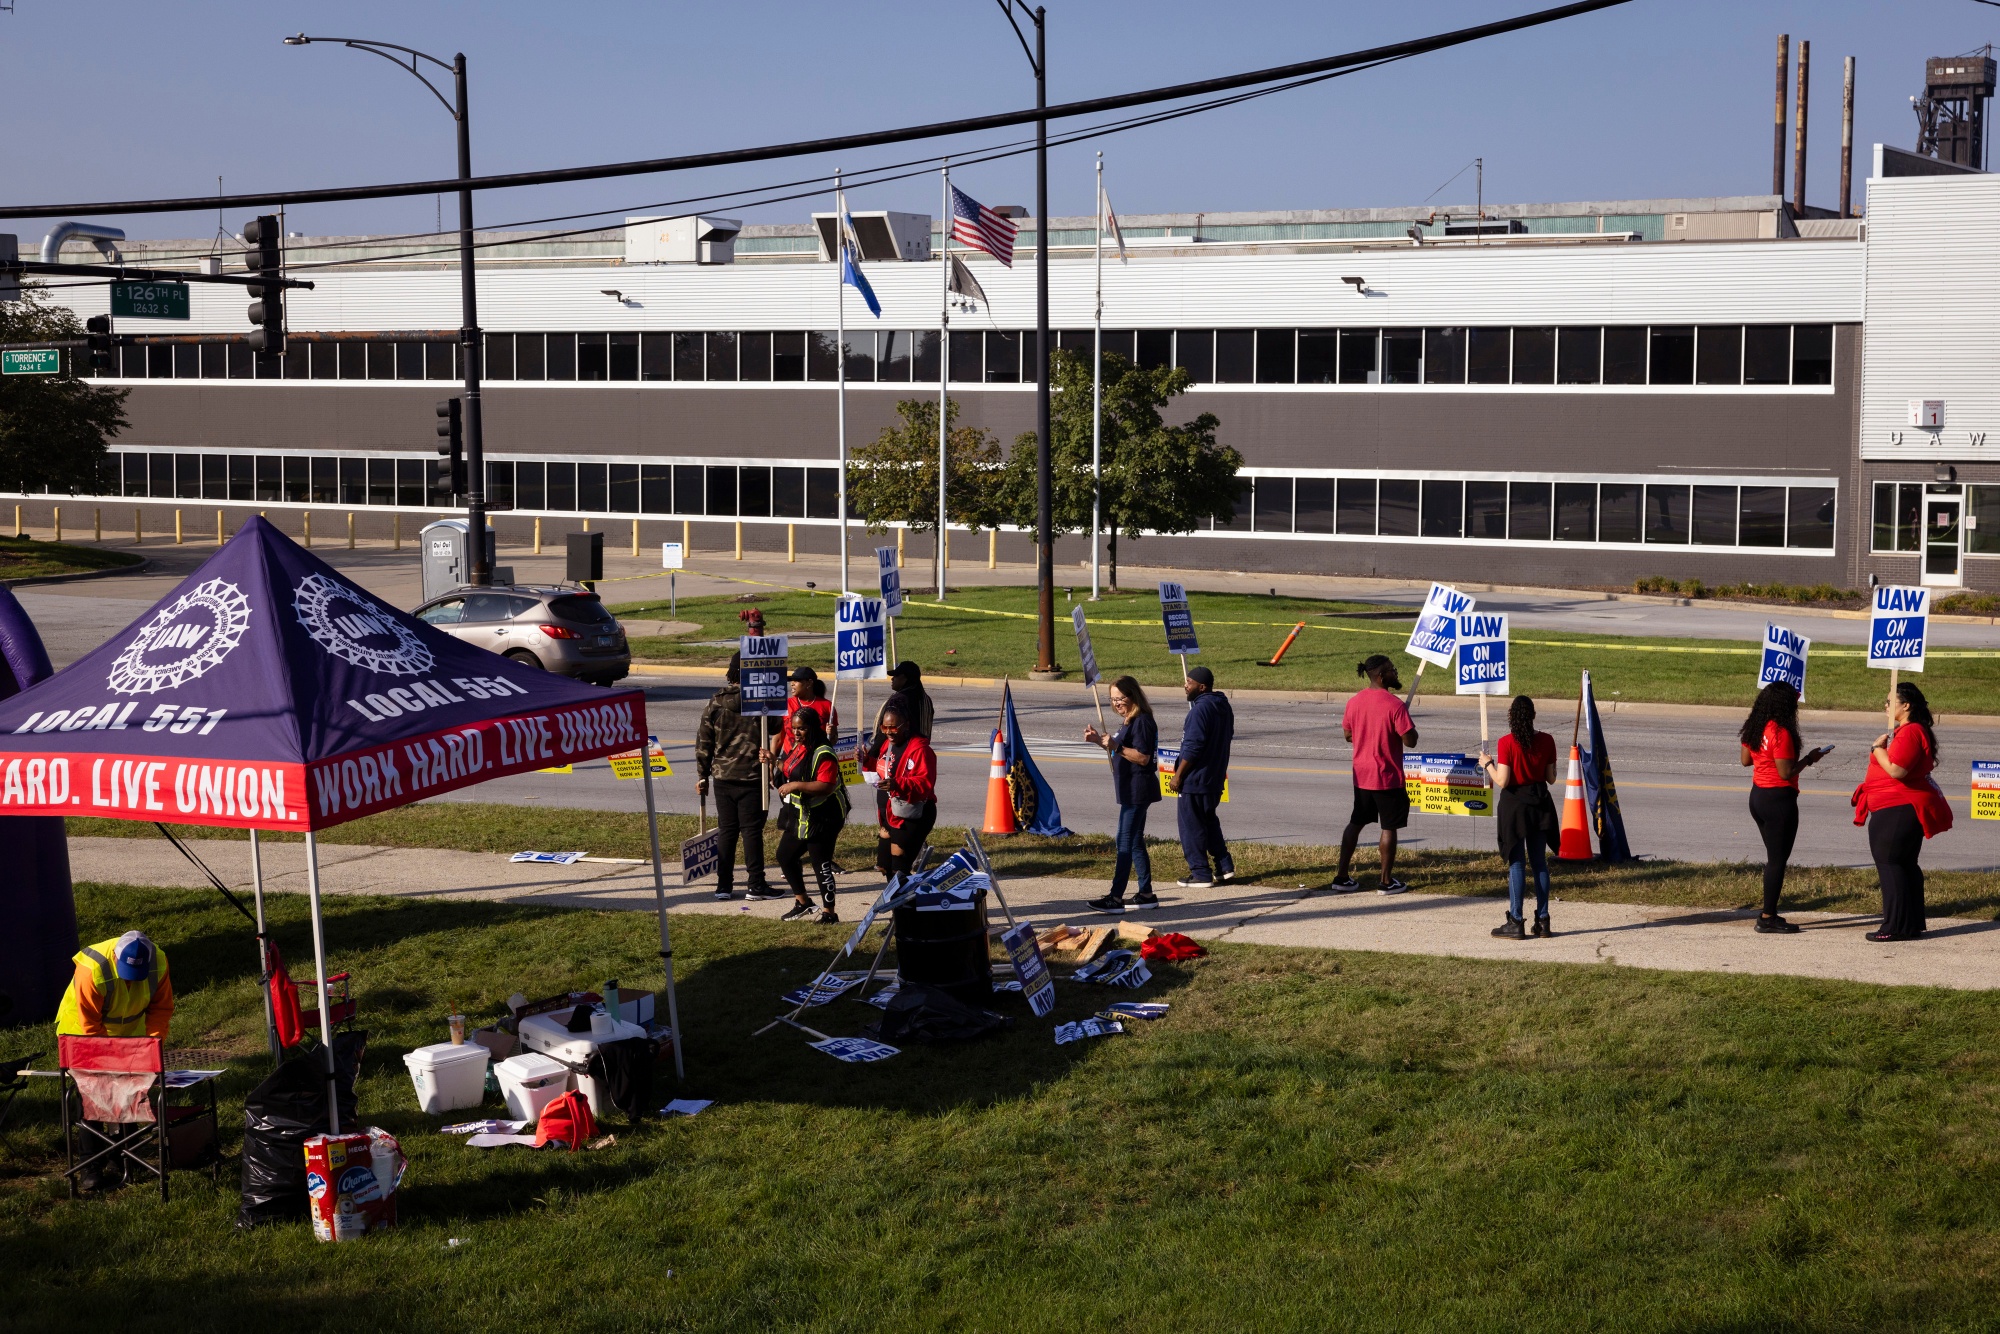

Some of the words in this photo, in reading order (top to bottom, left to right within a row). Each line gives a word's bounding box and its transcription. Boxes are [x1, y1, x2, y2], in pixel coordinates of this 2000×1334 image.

[116, 288, 122, 296] E
[128, 286, 168, 300] 126TH
[172, 290, 184, 300] PL
[133, 303, 158, 314] 12632
[164, 305, 169, 314] S
[11, 353, 46, 363] TORRENCE
[1931, 413, 1936, 424] 1
[880, 549, 896, 568] UAW
[1430, 586, 1470, 613] UAW
[1878, 588, 1925, 612] UAW
[840, 602, 881, 623] UAW
[334, 614, 390, 639] UAW
[1430, 616, 1449, 633] ON
[1461, 616, 1503, 637] UAW
[1886, 619, 1908, 637] ON
[148, 624, 210, 651] UAW
[851, 631, 868, 647] ON
[1414, 631, 1455, 653] STRIKE
[1769, 625, 1805, 655] UAW
[748, 639, 780, 655] UAW
[1473, 645, 1490, 661] ON
[1873, 638, 1922, 657] STRIKE
[840, 646, 883, 667] STRIKE
[1776, 653, 1792, 669] ON
[749, 672, 780, 684] END
[1462, 662, 1505, 681] STRIKE
[1764, 667, 1801, 689] STRIKE
[348, 678, 466, 722] LOCAL
[452, 676, 529, 700] 551
[743, 685, 785, 698] TIERS
[11, 702, 139, 735] LOCAL
[142, 704, 228, 735] 551
[313, 749, 403, 817] WORK
[404, 728, 493, 791] HARD.
[493, 716, 554, 766] LIVE
[555, 702, 640, 754] UNION.
[0, 758, 80, 805] ARD.
[92, 759, 166, 811] LIVE
[174, 764, 298, 820] UNION.
[1450, 788, 1486, 797] EQUITABLE
[698, 850, 711, 862] ON
[932, 864, 956, 880] RECORD
[948, 870, 968, 884] STAND
[820, 861, 835, 903] Calvin
[1026, 985, 1034, 995] UP
[348, 1145, 368, 1154] MEGA
[330, 1156, 346, 1164] 120
